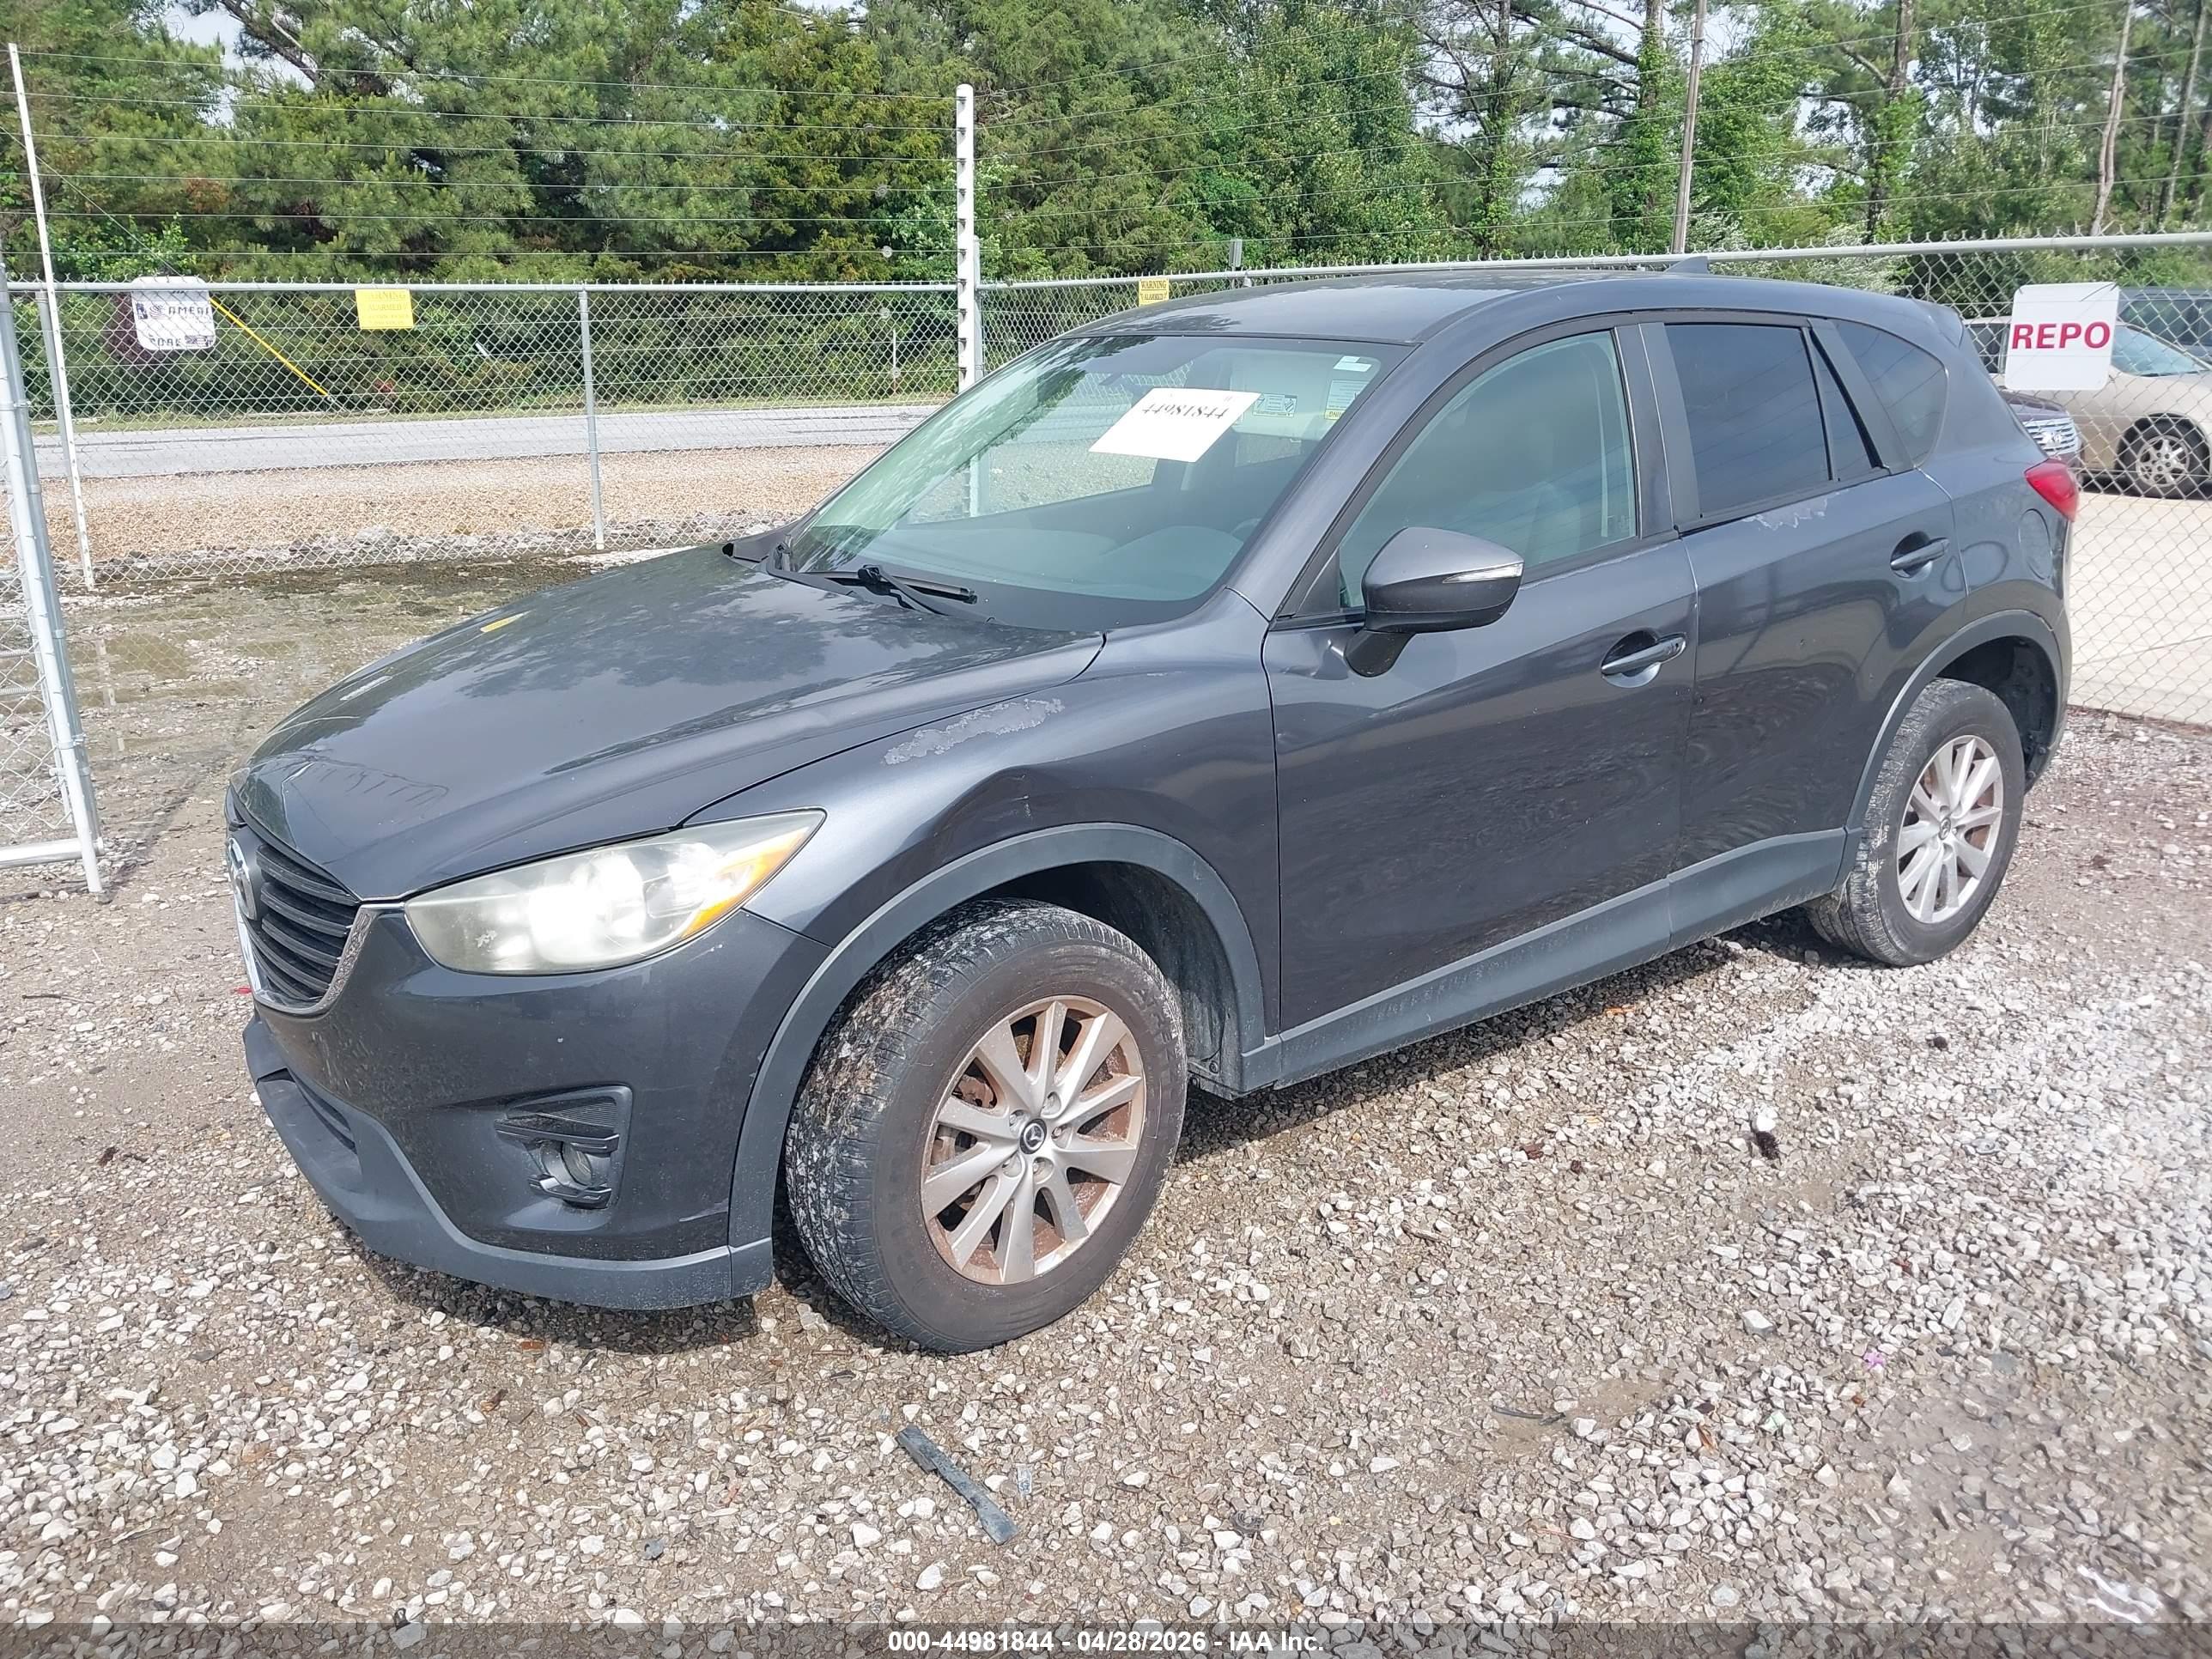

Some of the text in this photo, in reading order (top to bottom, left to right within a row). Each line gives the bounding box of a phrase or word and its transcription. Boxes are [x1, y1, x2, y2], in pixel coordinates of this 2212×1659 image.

[1140, 280, 1167, 289] WARNING
[2011, 321, 2111, 349] REPO
[1141, 404, 1230, 419] 44981844
